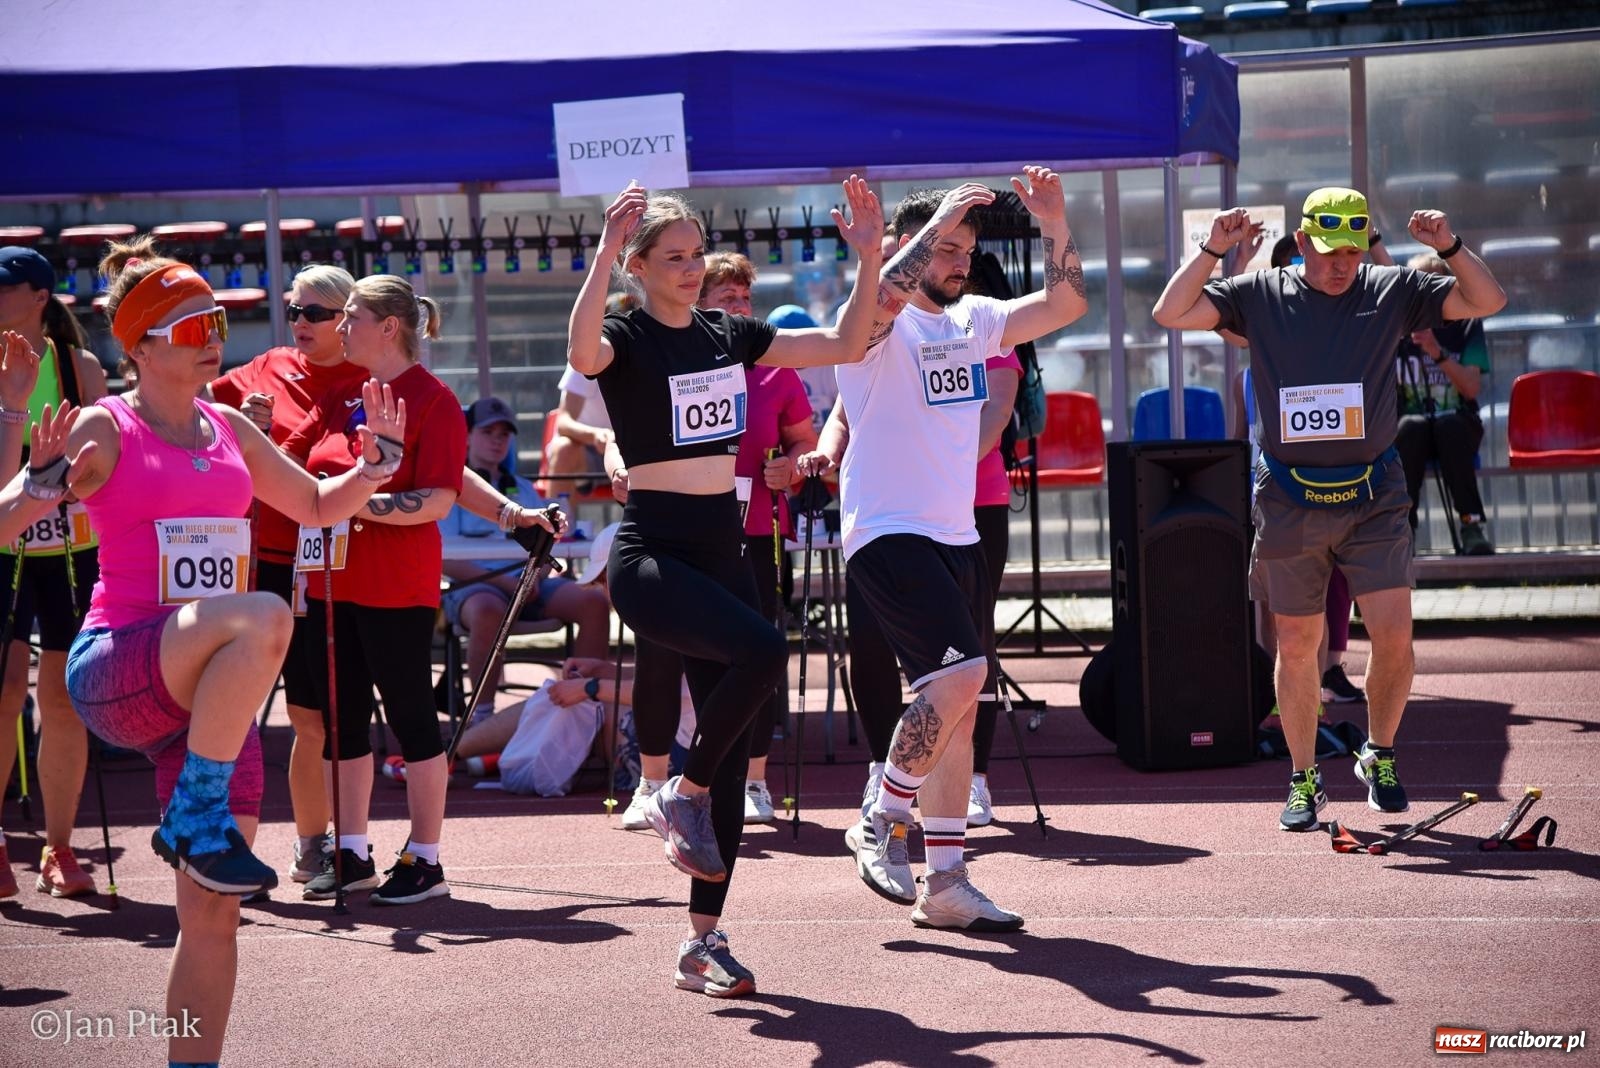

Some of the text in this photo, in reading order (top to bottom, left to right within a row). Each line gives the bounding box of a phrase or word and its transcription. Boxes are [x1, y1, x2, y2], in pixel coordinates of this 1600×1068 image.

[569, 134, 675, 160] DEPOZYT
[691, 377, 705, 386] BIEG
[705, 374, 715, 383] BEZ
[929, 367, 969, 394] 036
[686, 398, 732, 430] 032
[1291, 408, 1340, 431] 099
[1305, 488, 1358, 503] Reebok
[165, 525, 184, 534] XVIII
[185, 525, 202, 534] BIEG
[204, 525, 217, 534] BEZ
[166, 534, 209, 544] 3MAJA2026
[303, 538, 332, 559] 08
[174, 556, 233, 589] 098
